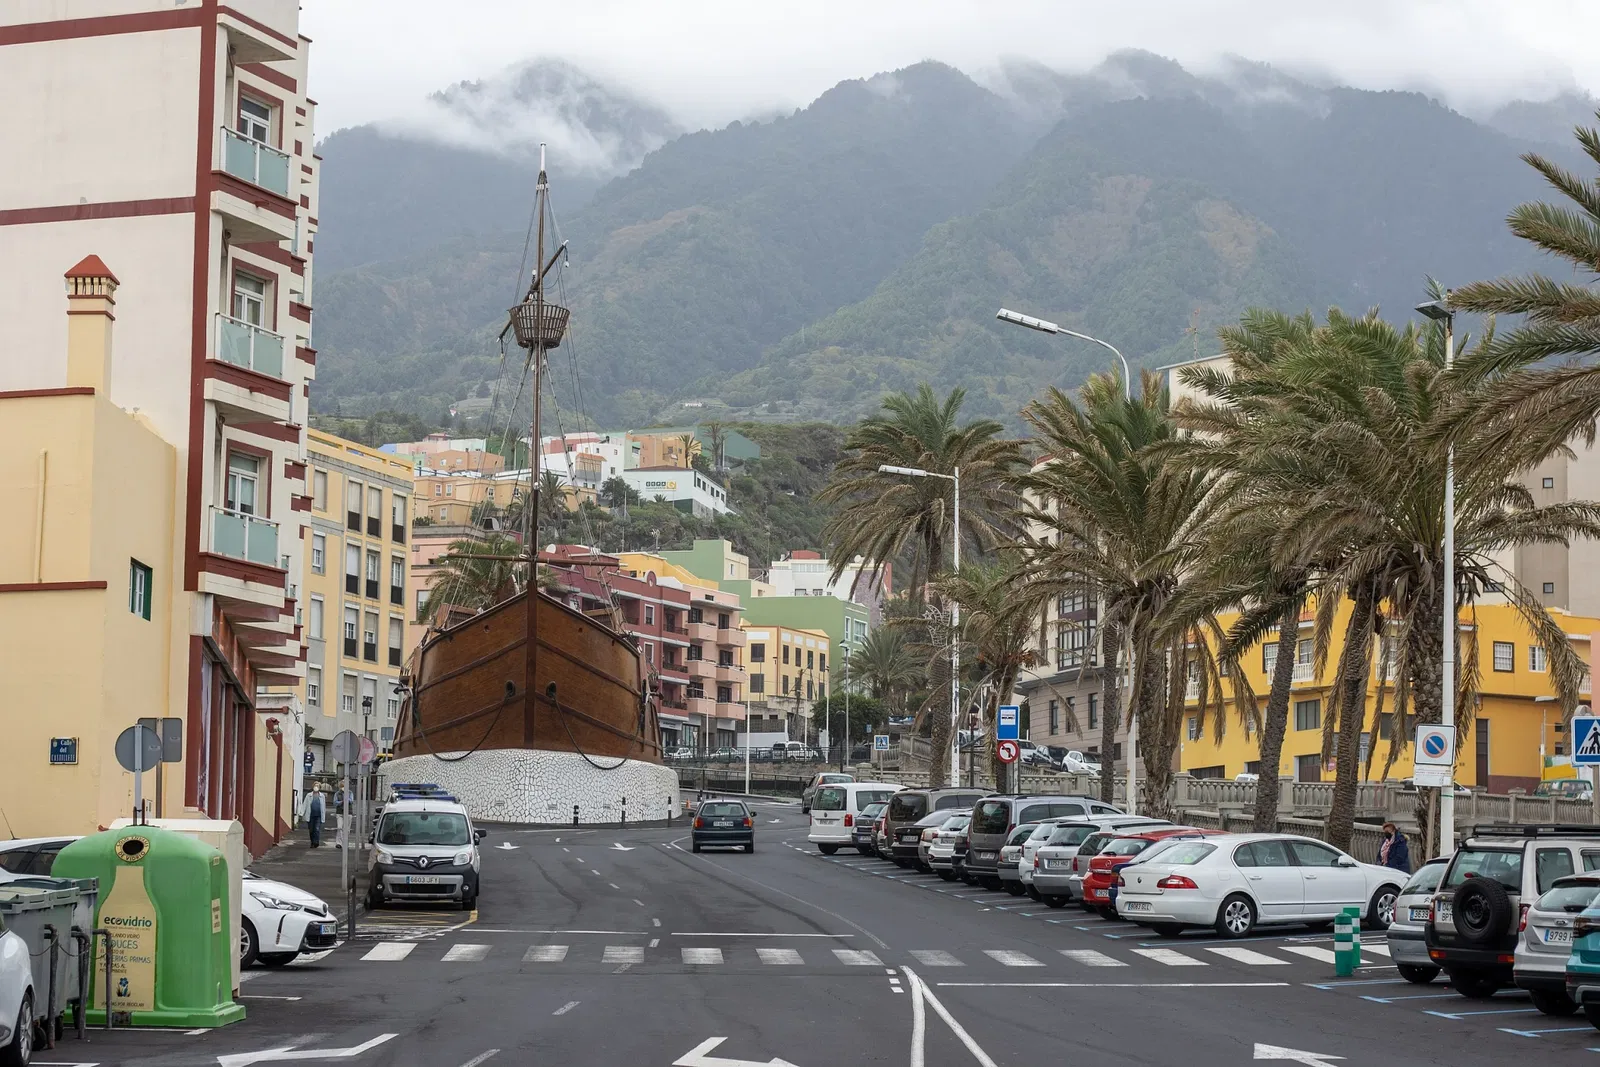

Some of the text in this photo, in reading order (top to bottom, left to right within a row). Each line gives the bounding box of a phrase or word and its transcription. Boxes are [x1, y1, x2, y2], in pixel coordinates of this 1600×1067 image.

[104, 915, 153, 928] ecovidrio
[1549, 930, 1568, 941] 9799
[129, 955, 151, 964] PRIMAS
